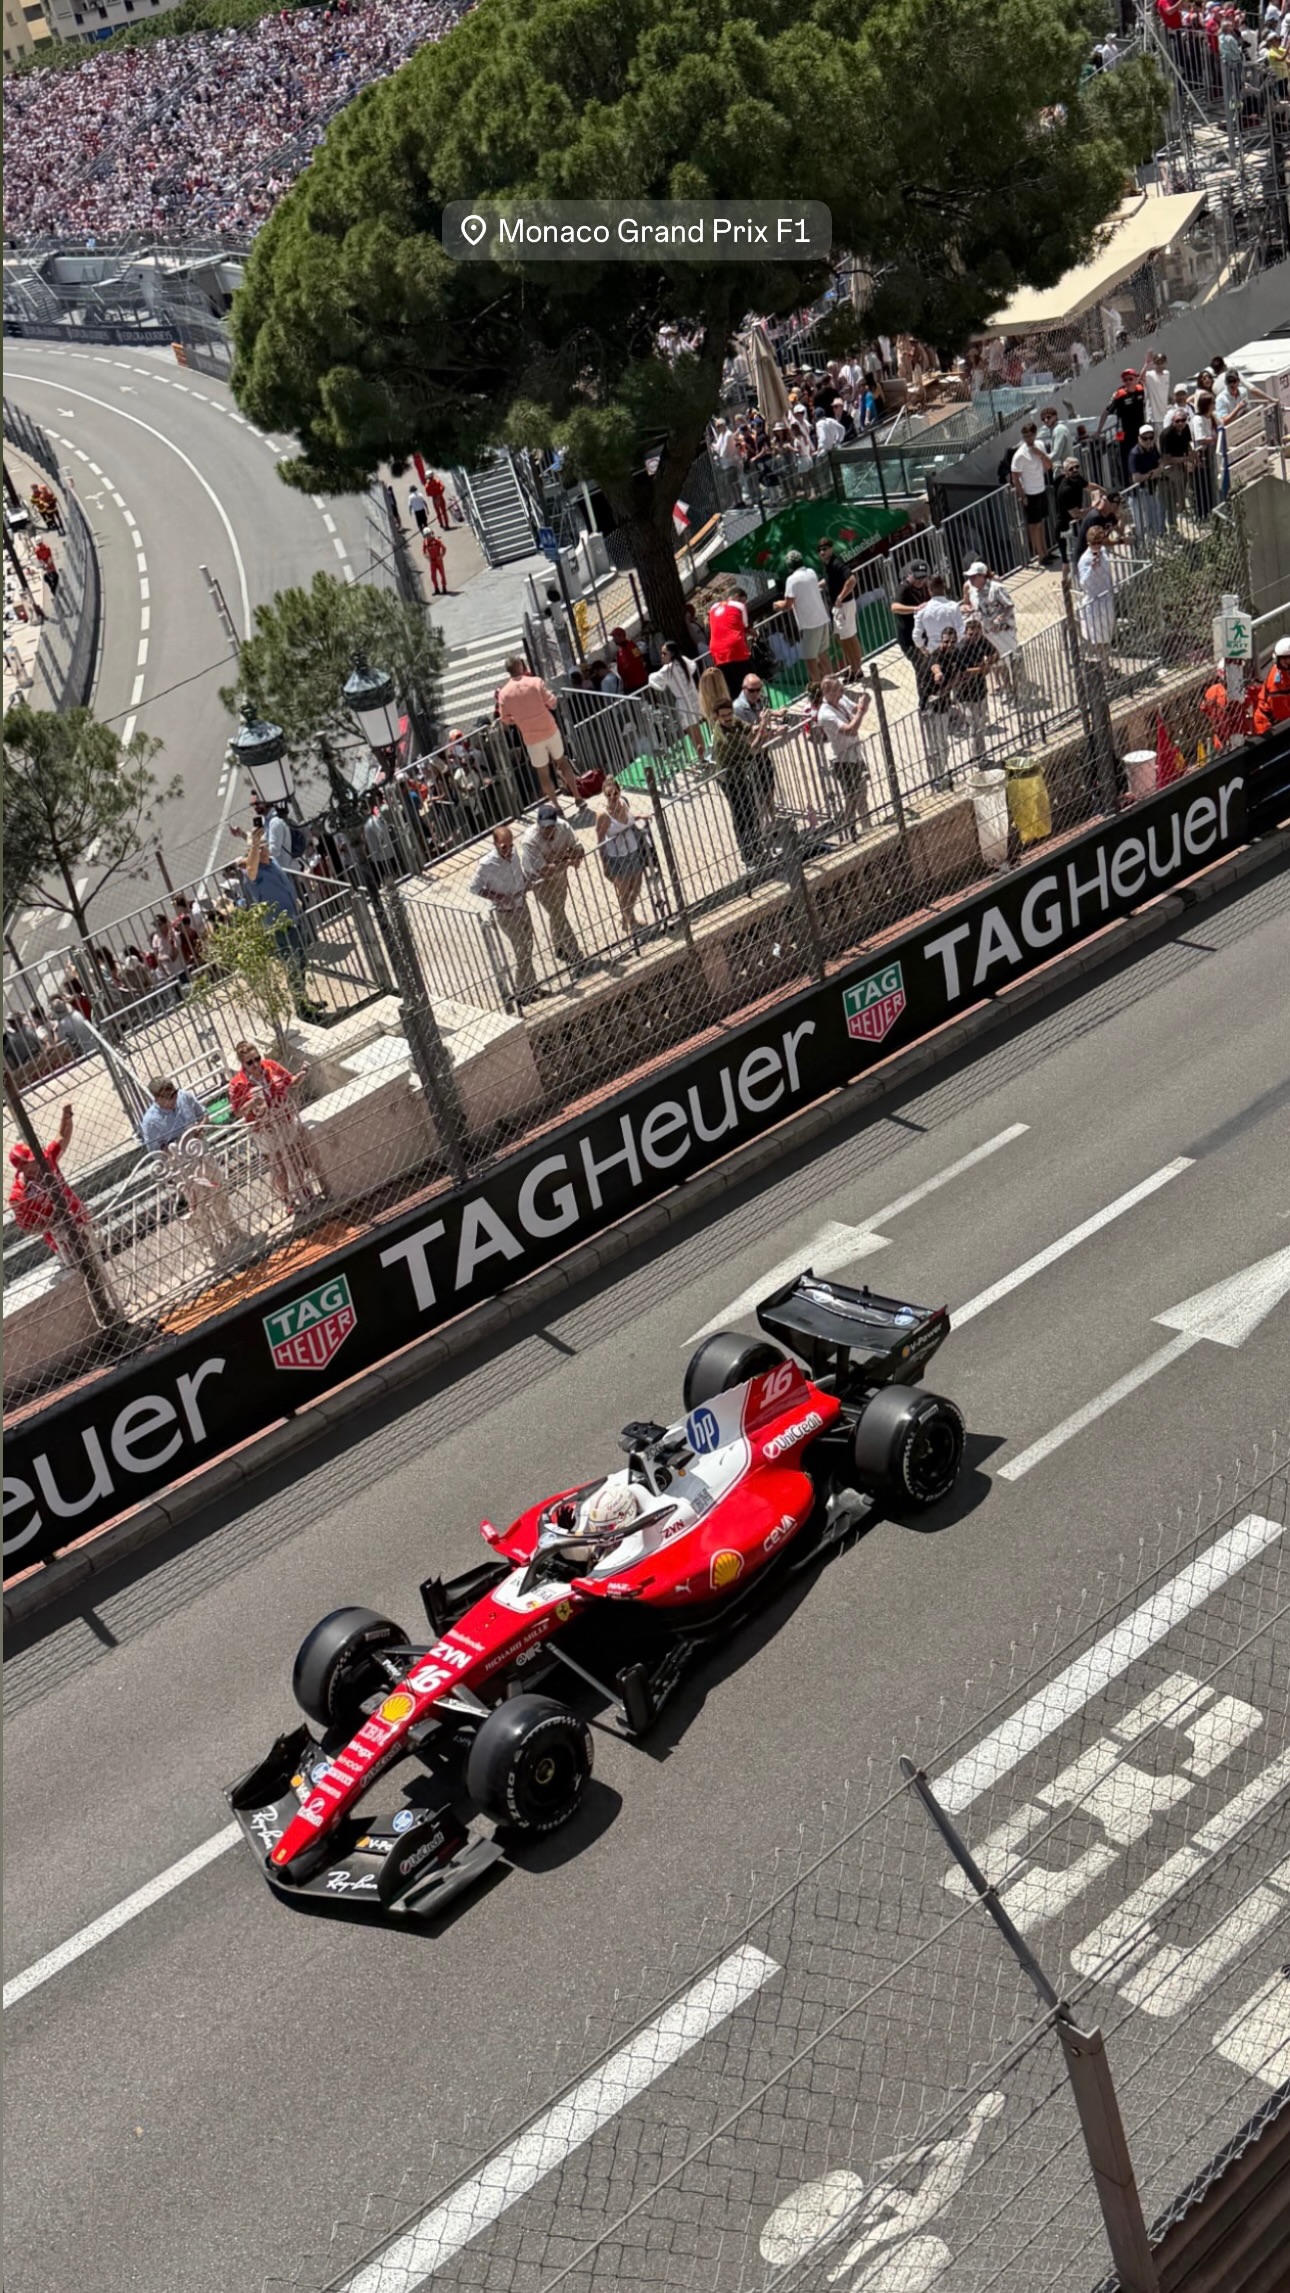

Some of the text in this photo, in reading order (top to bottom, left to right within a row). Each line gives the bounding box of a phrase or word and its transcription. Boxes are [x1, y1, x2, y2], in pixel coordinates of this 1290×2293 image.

[848, 969, 899, 1011] TAG
[849, 993, 905, 1038] HEUER
[271, 1284, 344, 1338] TAG
[276, 1308, 353, 1365] HEUER
[760, 1360, 793, 1409] 16
[688, 1407, 718, 1454] hp
[776, 1412, 823, 1451] UniCredit
[662, 1519, 685, 1539] ZYN
[429, 1641, 472, 1669] ZYN
[484, 1622, 549, 1670] RICHARD MILLE
[411, 1664, 452, 1693] 16
[358, 1722, 388, 1747] IBM
[251, 1806, 284, 1849] Ray-Ban
[368, 1838, 393, 1851] V-Po
[326, 1871, 378, 1893] Ray-Ban
